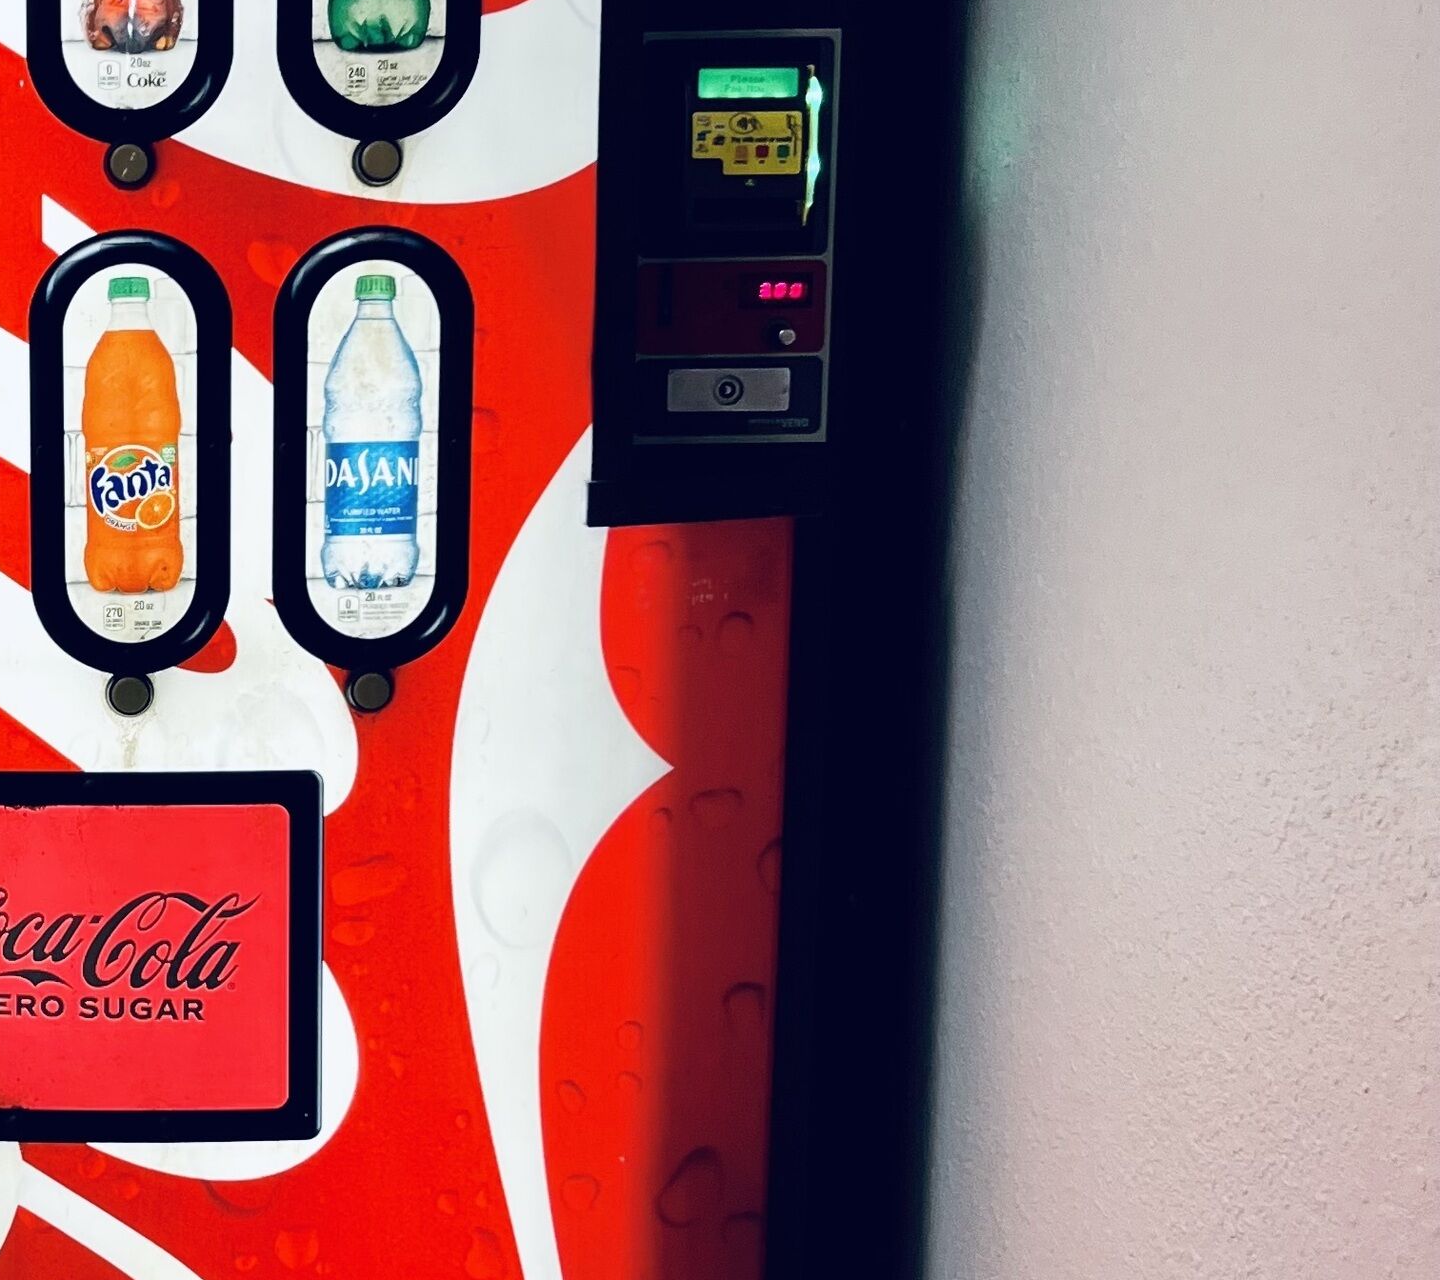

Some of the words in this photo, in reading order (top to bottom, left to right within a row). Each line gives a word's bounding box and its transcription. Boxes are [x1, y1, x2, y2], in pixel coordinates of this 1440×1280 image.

[377, 59, 389, 71] 20
[348, 67, 366, 78] 240
[126, 72, 167, 88] Coke
[326, 448, 419, 496] DASANI
[105, 607, 123, 618] 270
[78, 996, 205, 1021] SUGAR
